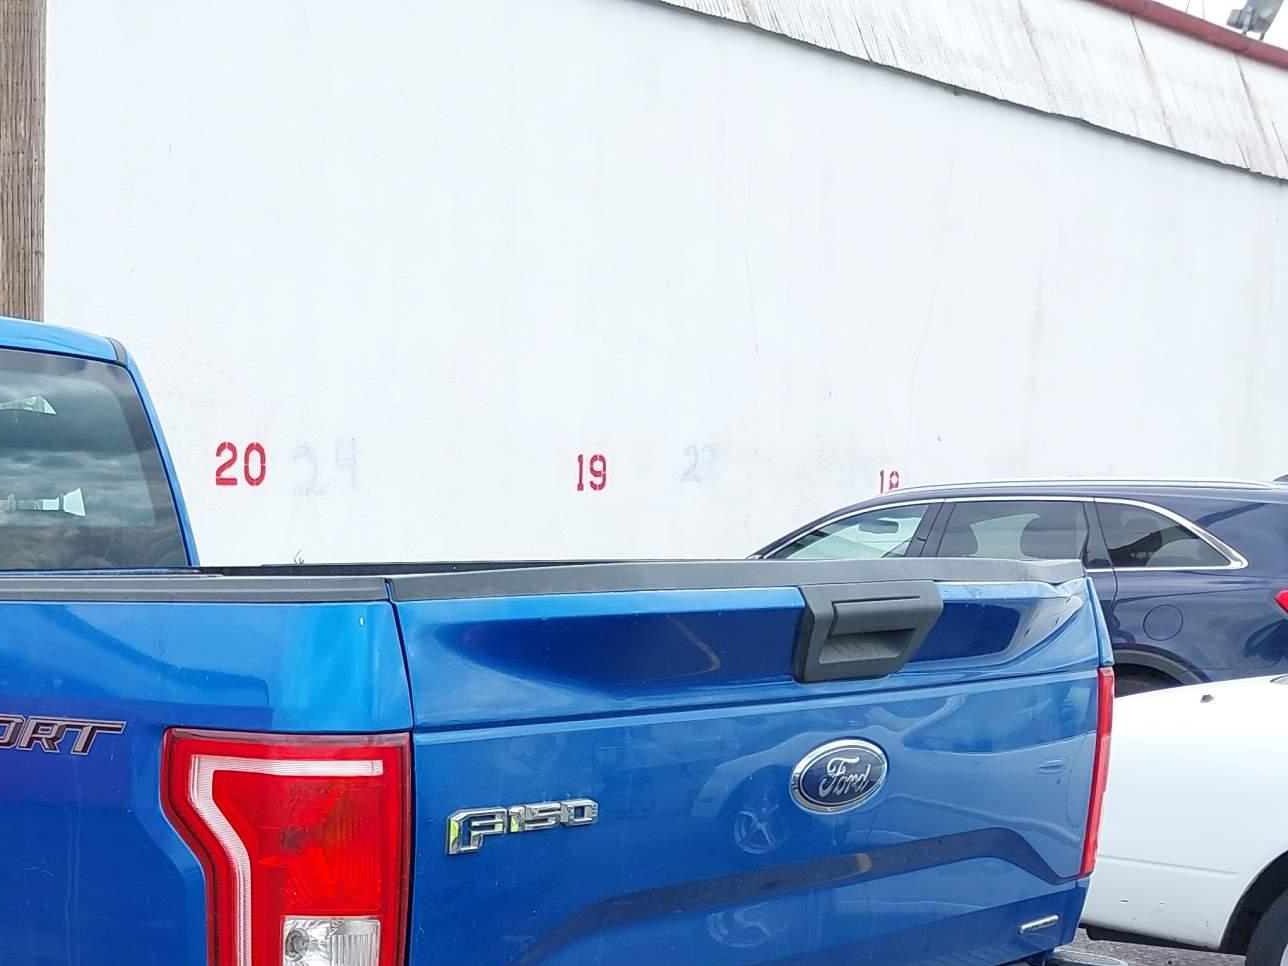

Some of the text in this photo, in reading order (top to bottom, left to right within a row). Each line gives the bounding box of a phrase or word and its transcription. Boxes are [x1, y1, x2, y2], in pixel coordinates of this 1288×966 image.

[215, 441, 266, 486] 20
[577, 454, 607, 491] 19
[818, 756, 872, 798] Ford
